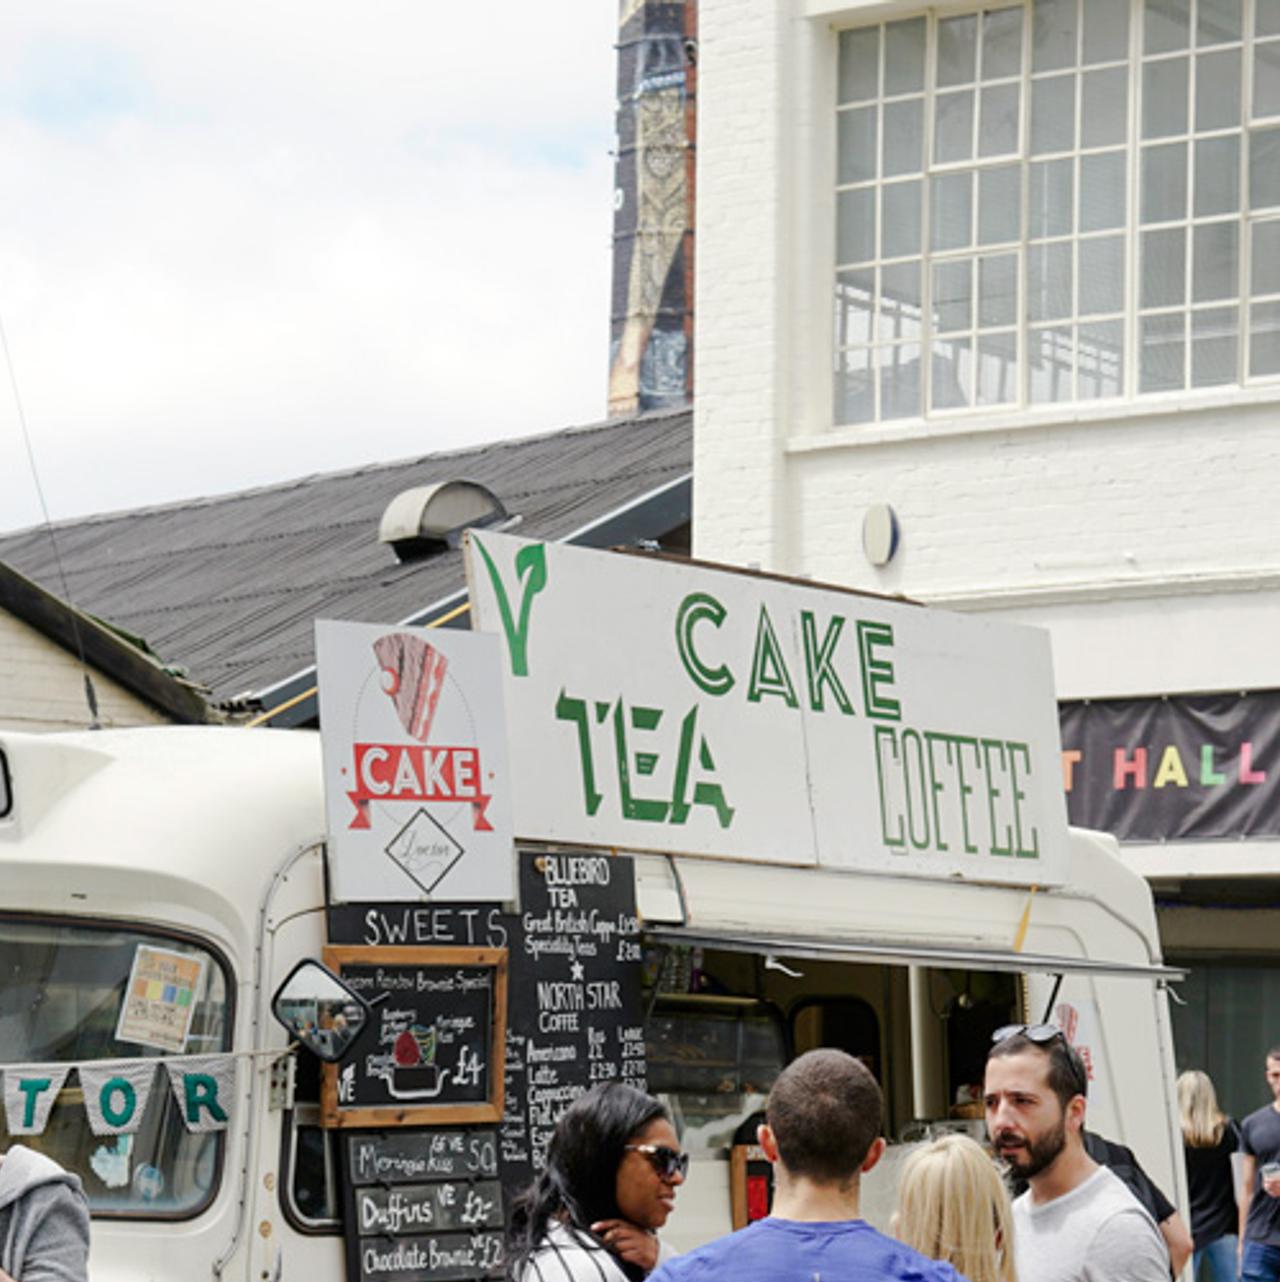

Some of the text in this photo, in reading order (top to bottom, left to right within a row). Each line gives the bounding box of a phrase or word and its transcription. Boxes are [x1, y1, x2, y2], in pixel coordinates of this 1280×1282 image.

[675, 592, 902, 721] CAKE
[360, 746, 478, 798] CAKE
[555, 686, 735, 828] TEA
[1113, 742, 1267, 791] HALL
[874, 724, 1040, 859] COFFEE
[544, 856, 611, 886] BLUEBIRD
[547, 888, 579, 908] TEA
[364, 909, 508, 950] SWEETS
[537, 980, 622, 1012] NORTH STAR
[451, 1045, 486, 1087] £4
[526, 1066, 559, 1085] Latte
[362, 1193, 433, 1232] Duffins
[437, 1184, 456, 1206] VE
[364, 1245, 427, 1274] Chocolate
[429, 1239, 476, 1269] Brownie
